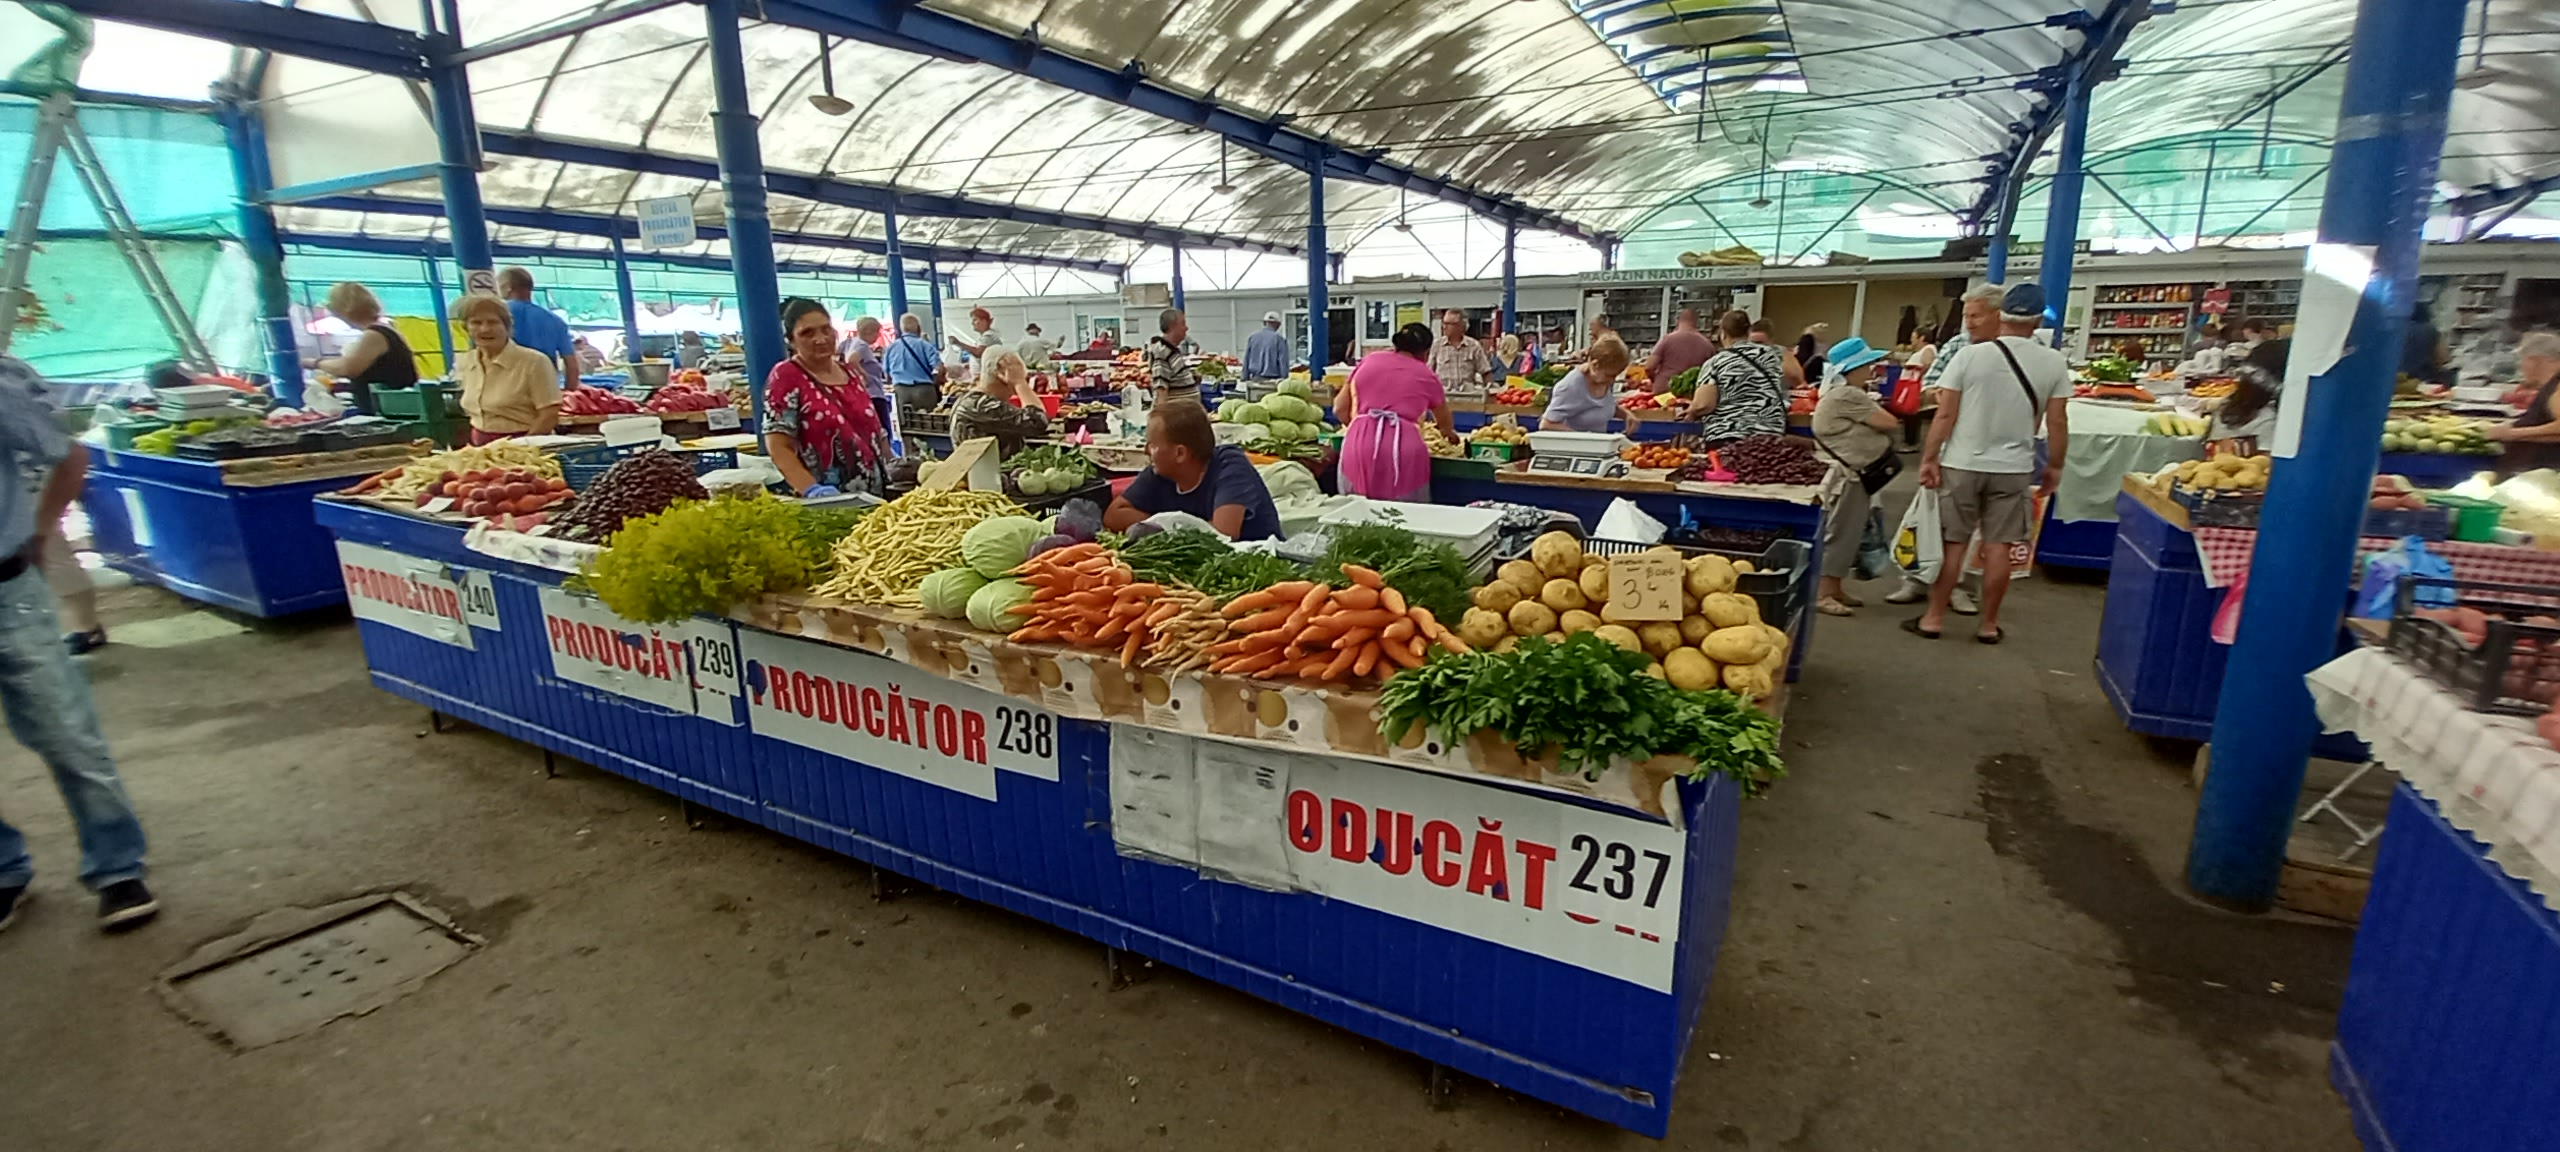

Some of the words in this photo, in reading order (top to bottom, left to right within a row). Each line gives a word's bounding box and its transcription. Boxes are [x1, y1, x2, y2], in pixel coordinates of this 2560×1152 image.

[1579, 270, 1644, 282] MAGAZIN
[1649, 267, 1714, 281] NATURIST
[463, 584, 496, 617] 240
[1623, 578, 1642, 610] 3
[547, 614, 704, 689] PRODUCĂT
[695, 636, 734, 680] 239
[996, 705, 1053, 759] 238
[1286, 788, 1601, 925] ODUCĂT
[1568, 833, 1672, 910] 237
